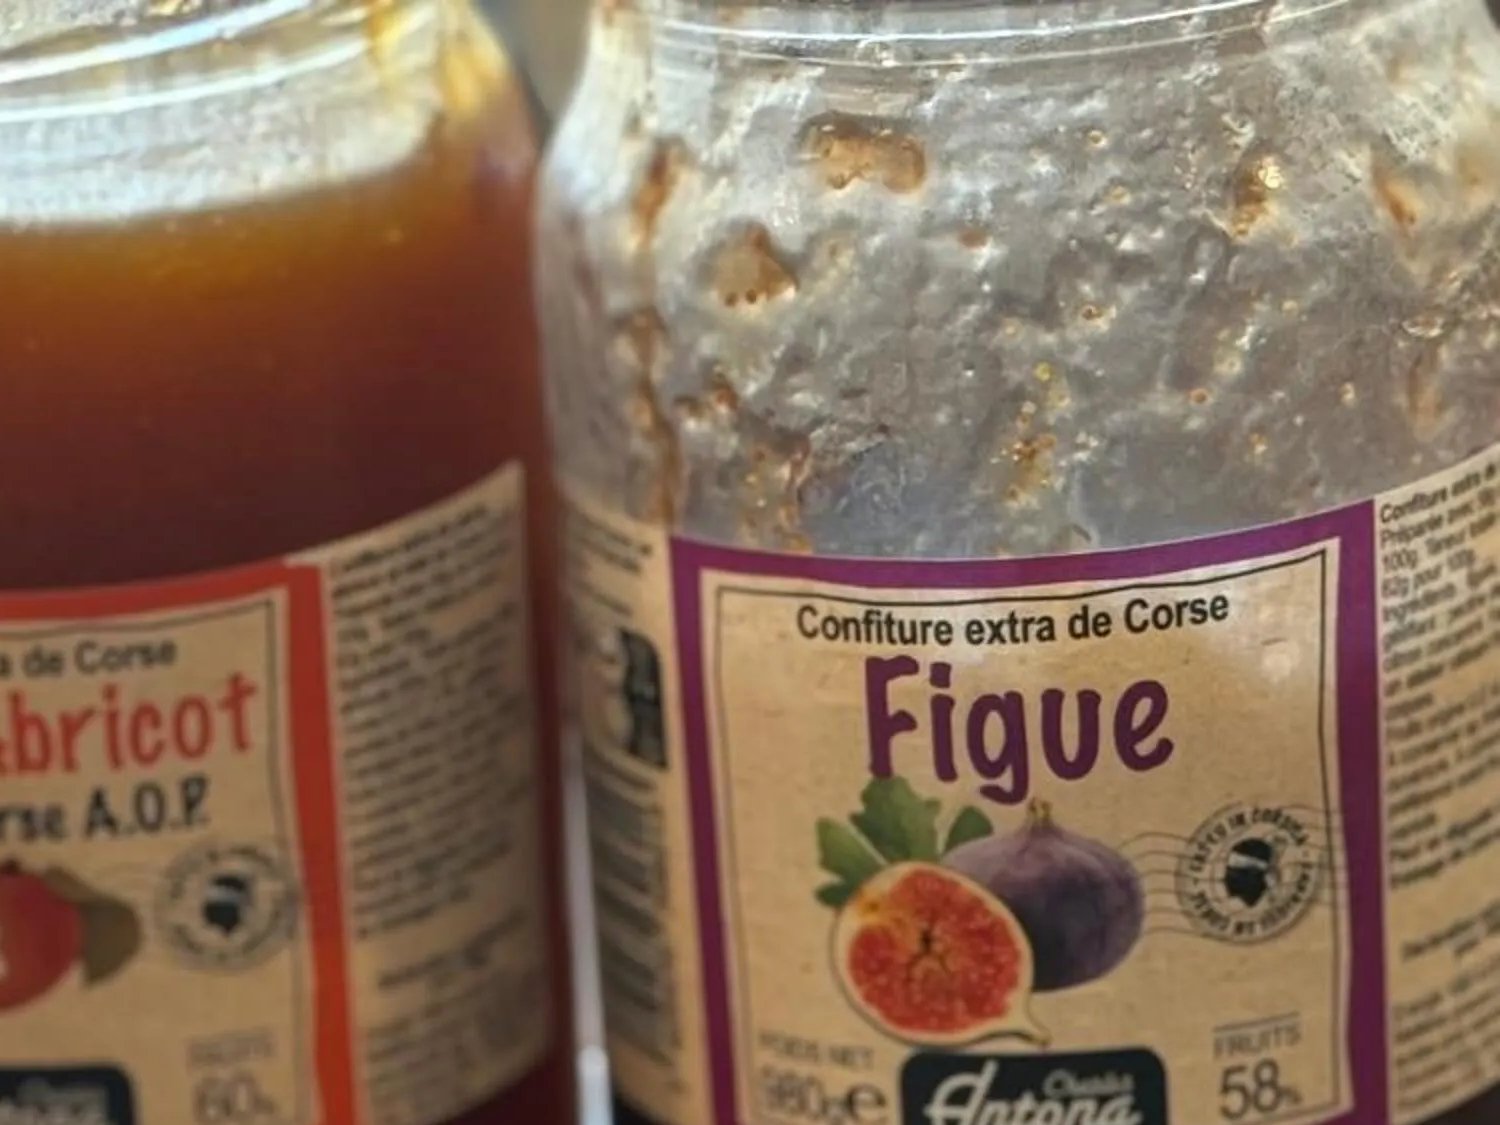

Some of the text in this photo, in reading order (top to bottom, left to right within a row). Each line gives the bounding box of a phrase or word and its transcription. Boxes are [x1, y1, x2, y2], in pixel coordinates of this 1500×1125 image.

[796, 593, 1231, 647] Confiture extra de Corse
[22, 644, 66, 679] de
[74, 639, 178, 675] Corse
[865, 654, 1175, 805] Figue
